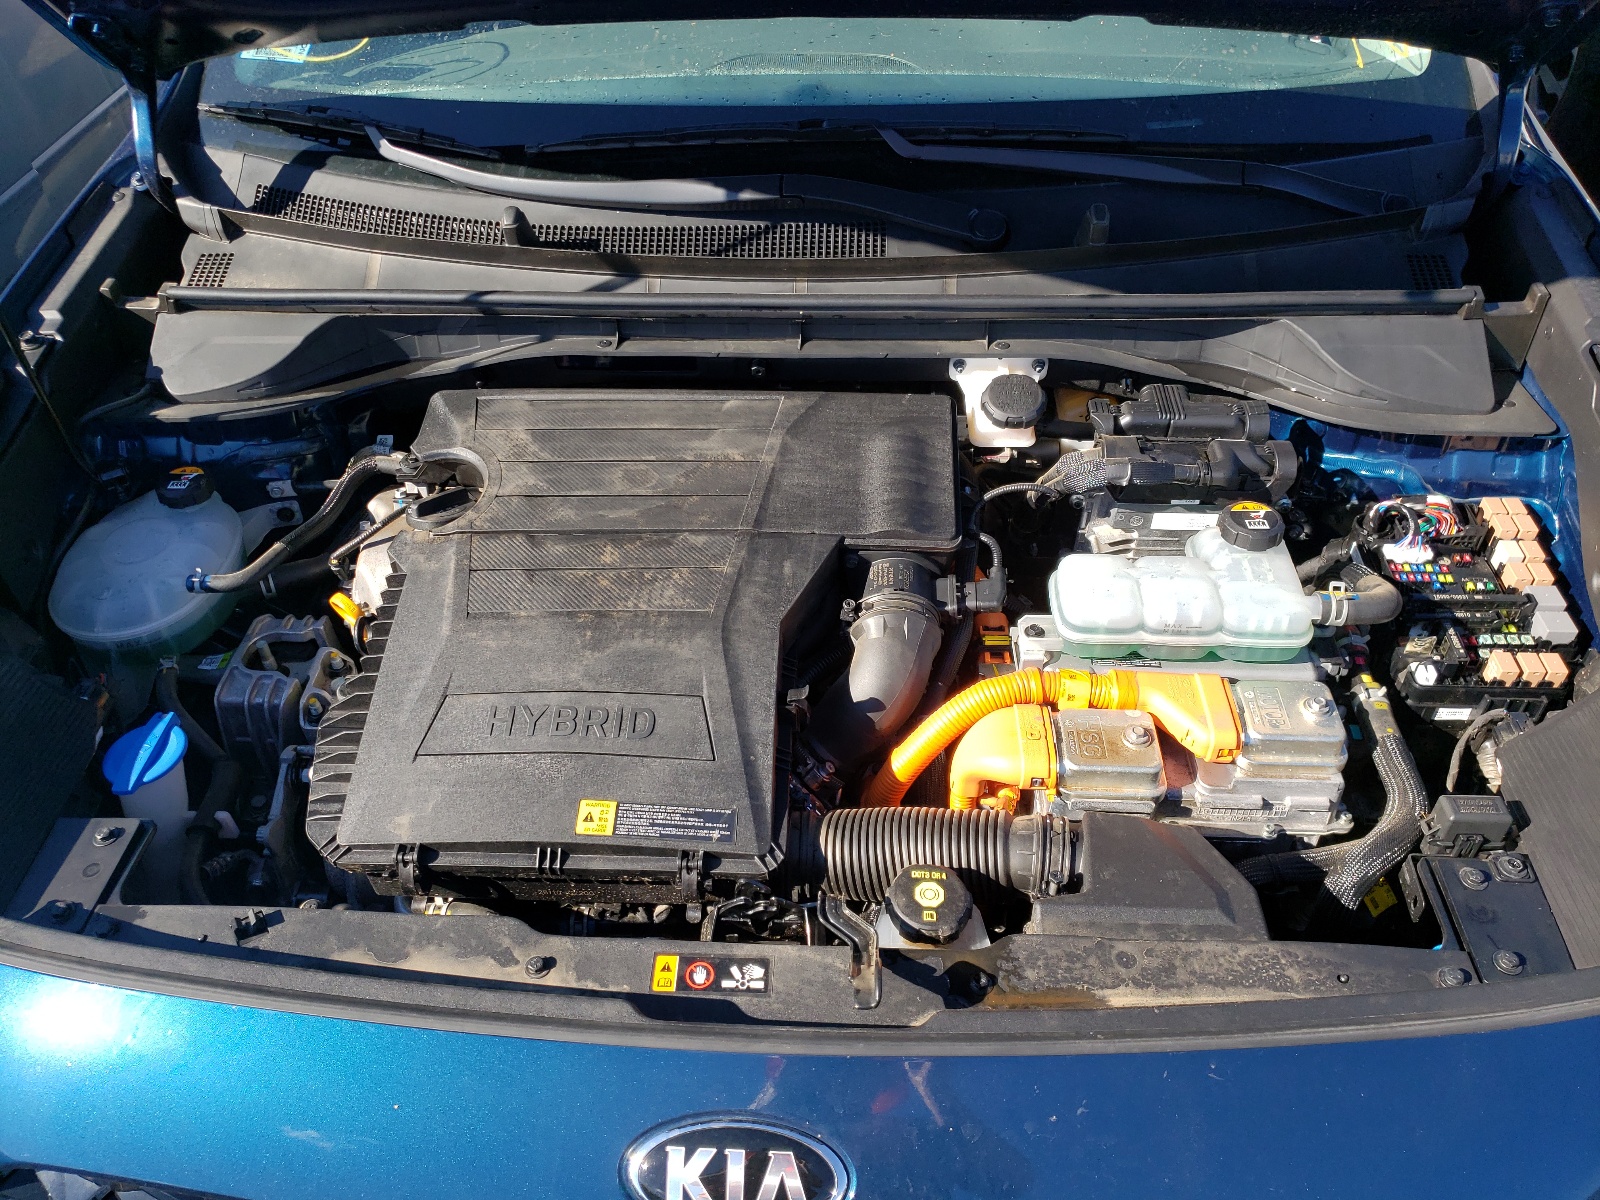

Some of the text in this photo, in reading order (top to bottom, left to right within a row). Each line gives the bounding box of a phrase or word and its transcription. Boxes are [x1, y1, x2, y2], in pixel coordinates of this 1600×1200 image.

[485, 704, 657, 740] HYBRID
[911, 870, 947, 880] DOT3 OR 4
[665, 1145, 807, 1200] KIA
